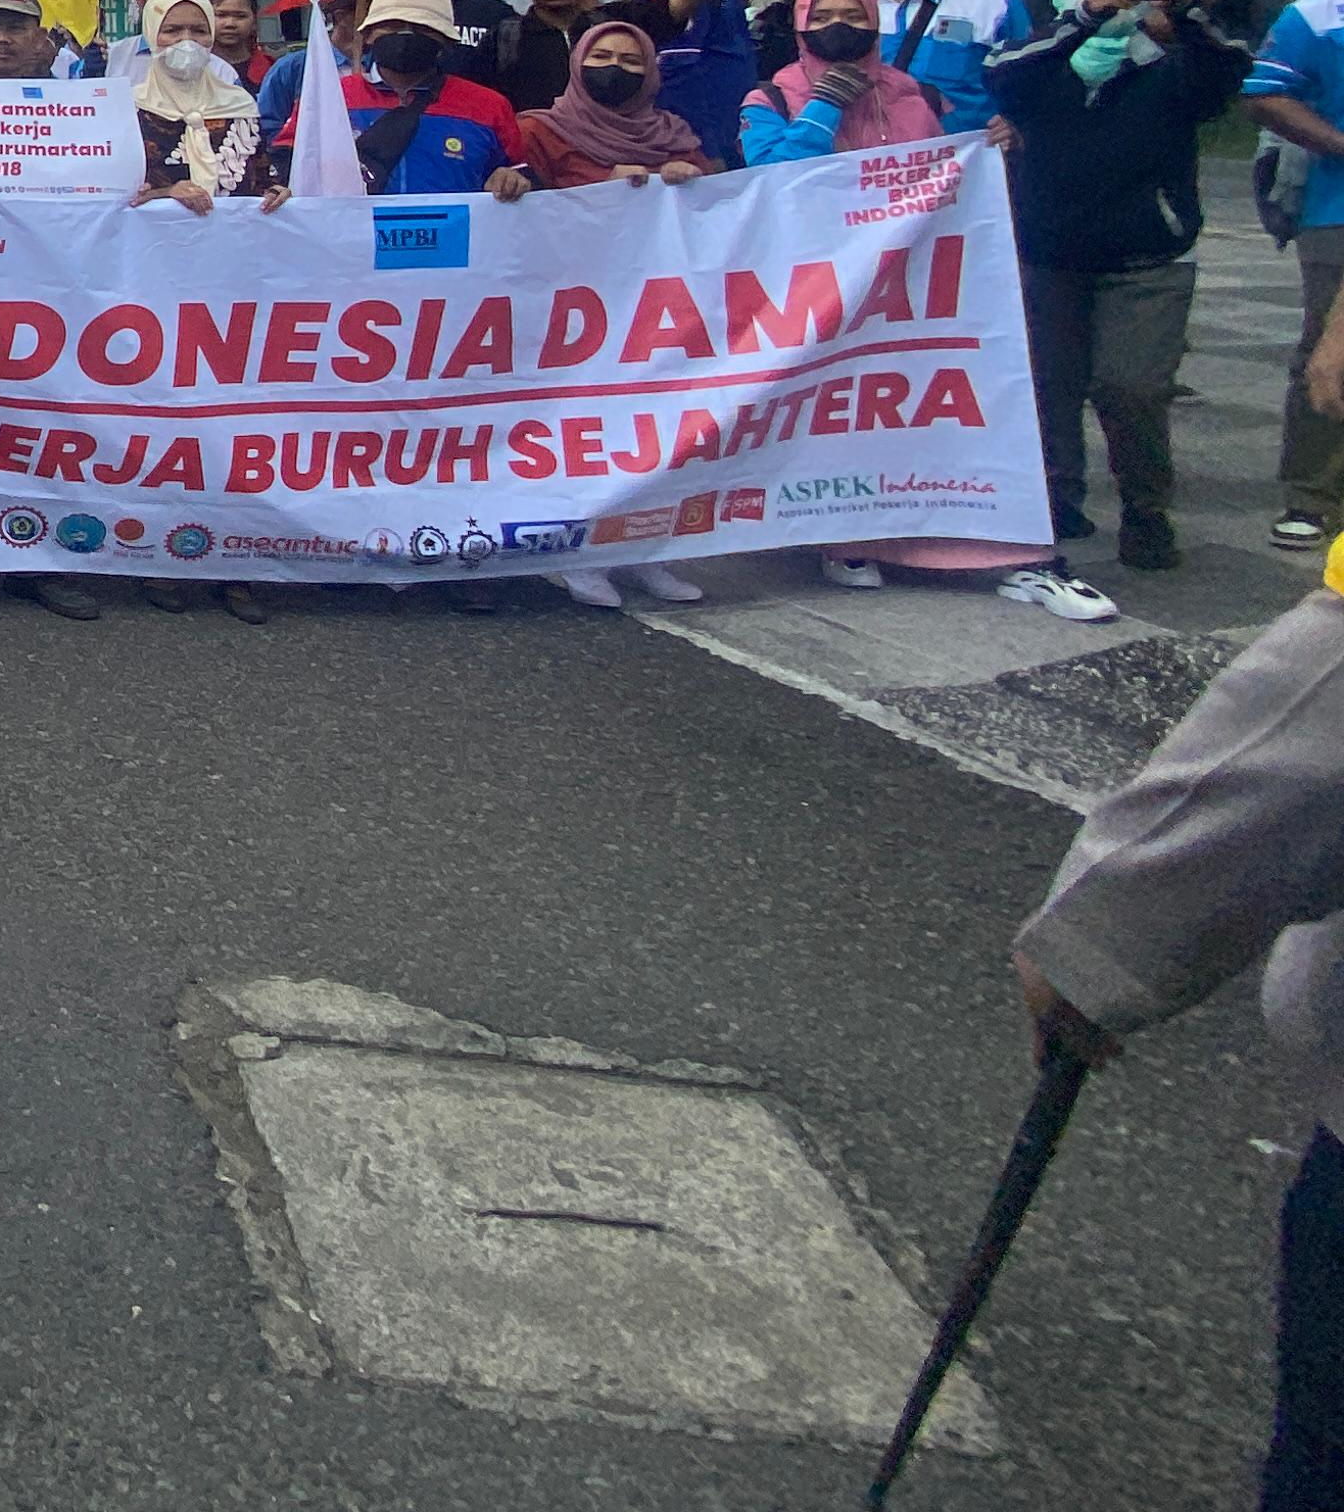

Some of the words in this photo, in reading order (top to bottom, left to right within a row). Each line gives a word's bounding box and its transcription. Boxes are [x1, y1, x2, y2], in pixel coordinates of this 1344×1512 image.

[859, 160, 962, 191] PEKERJA
[860, 145, 956, 174] MAJELIS
[376, 228, 439, 248] MPBI
[537, 235, 965, 370] DAMAI
[223, 424, 494, 495] BURUH
[507, 367, 986, 479] SEJAHTERA
[776, 475, 876, 505] ASPEK
[878, 472, 997, 494] Indonesia
